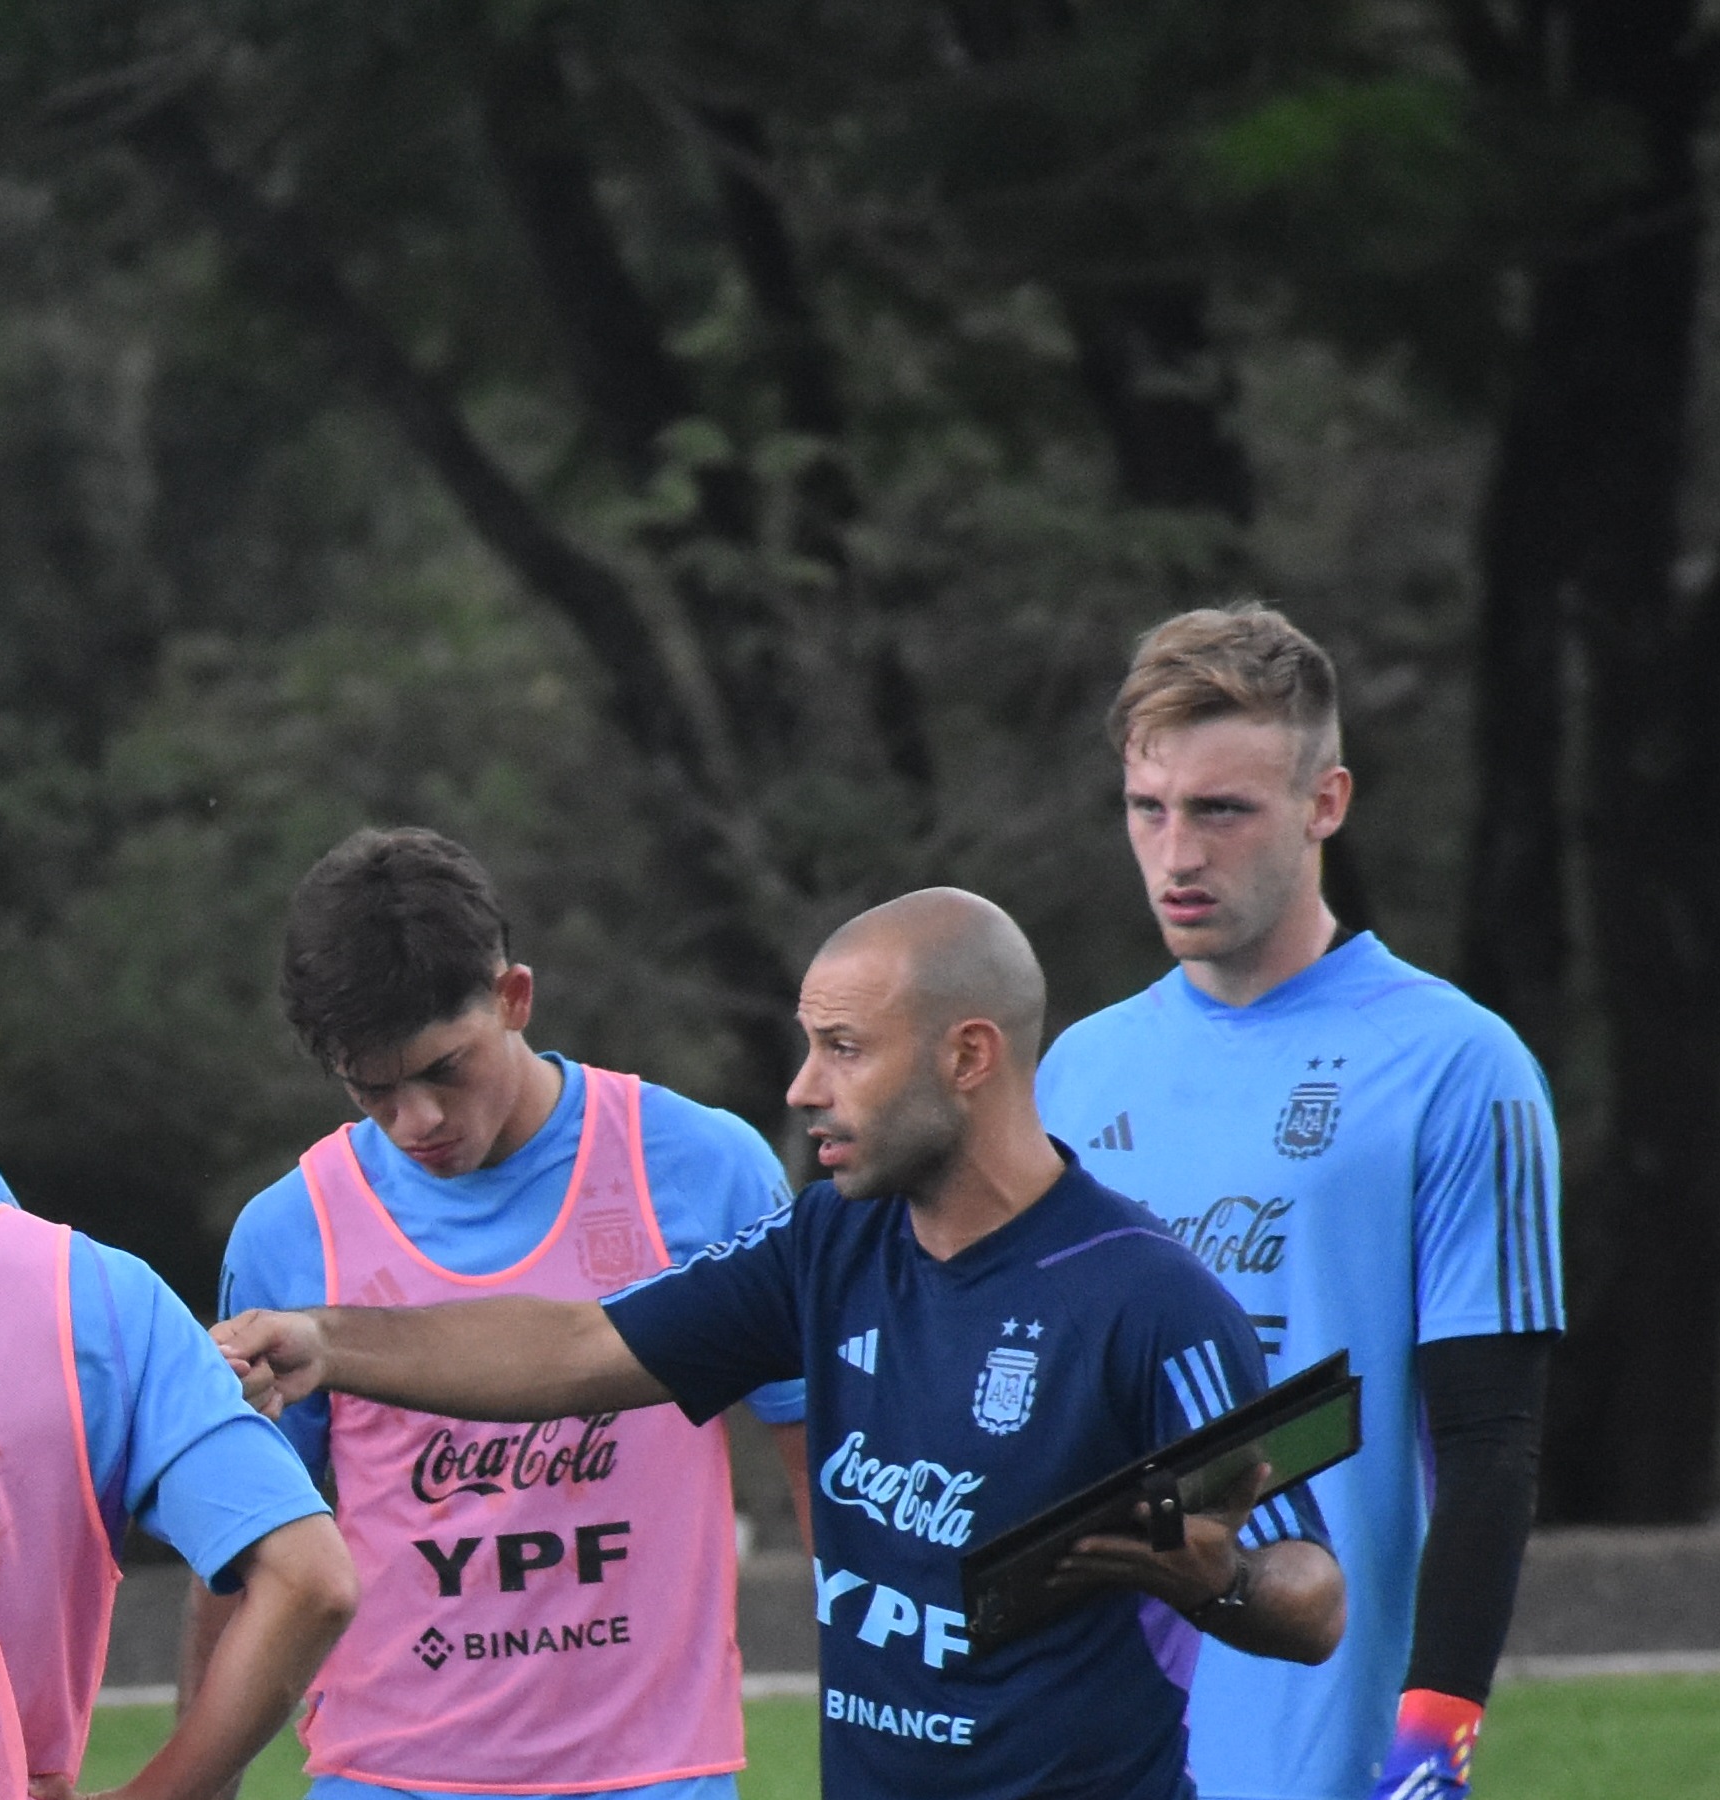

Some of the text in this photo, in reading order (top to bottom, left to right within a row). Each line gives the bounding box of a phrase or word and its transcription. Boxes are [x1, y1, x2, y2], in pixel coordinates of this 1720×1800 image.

[820, 1431, 986, 1548] Coca-Cola
[411, 1521, 630, 1597] YPF
[464, 1616, 630, 1660] BINANCE
[813, 1555, 969, 1669] YPF
[827, 1689, 976, 1746] BINANCE
